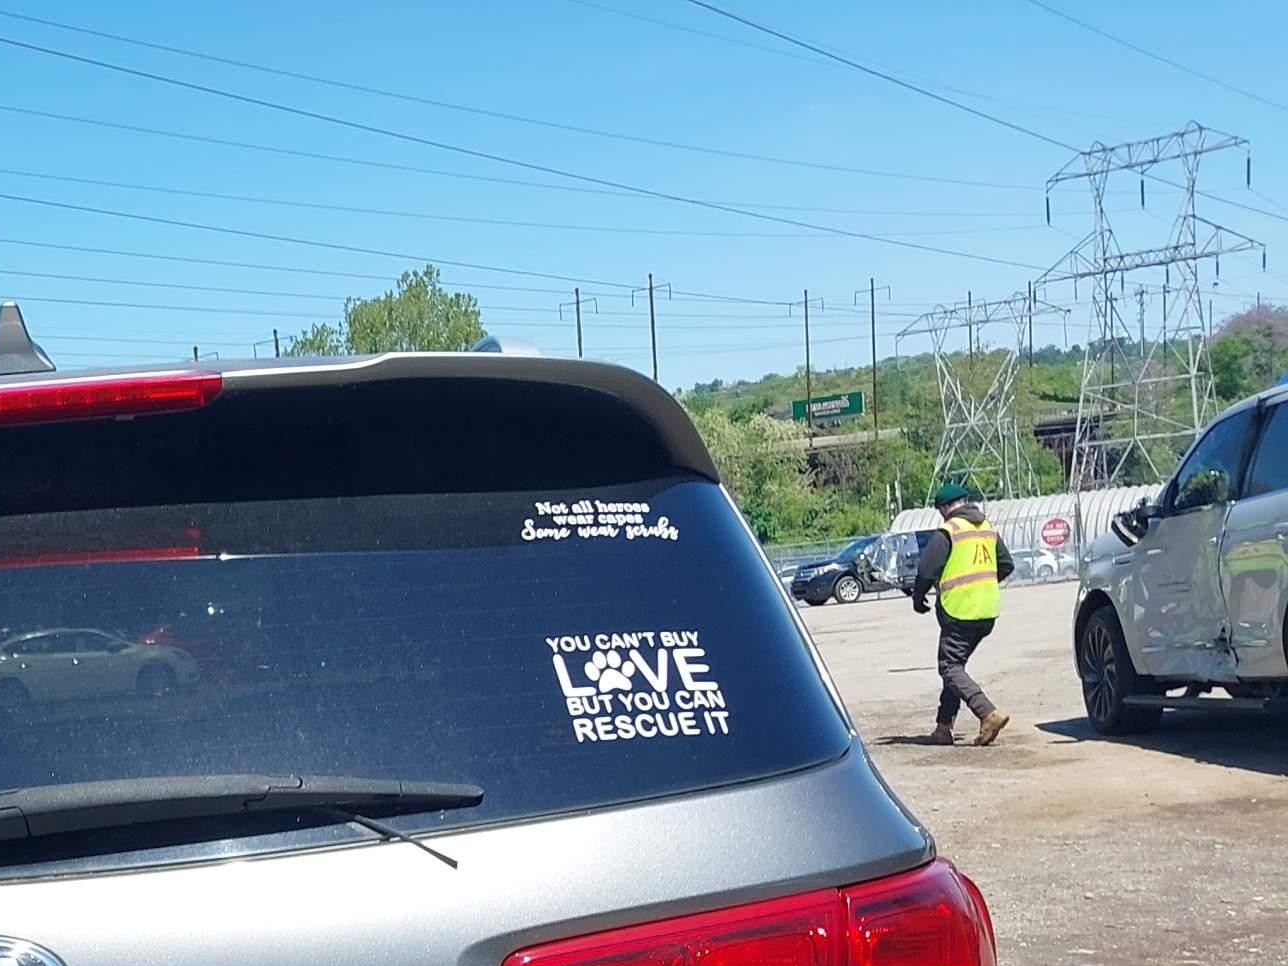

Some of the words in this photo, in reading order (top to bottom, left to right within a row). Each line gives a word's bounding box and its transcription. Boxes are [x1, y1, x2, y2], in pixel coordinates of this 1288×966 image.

[535, 501, 569, 515] Not
[571, 500, 594, 514] all
[595, 500, 650, 513] heroes
[553, 514, 594, 525] wear
[598, 513, 644, 526] capes
[521, 519, 571, 541] Some
[578, 525, 619, 538] wear
[625, 516, 679, 541] scrubs
[546, 635, 591, 653] YOU
[595, 631, 655, 649] CAN'T
[660, 631, 698, 647] BUY
[552, 648, 719, 697] LVE
[566, 694, 613, 716] BUT
[618, 691, 670, 712] YOU
[675, 690, 726, 710] CAN
[572, 712, 701, 743] RESCUE
[704, 711, 729, 735] IT
